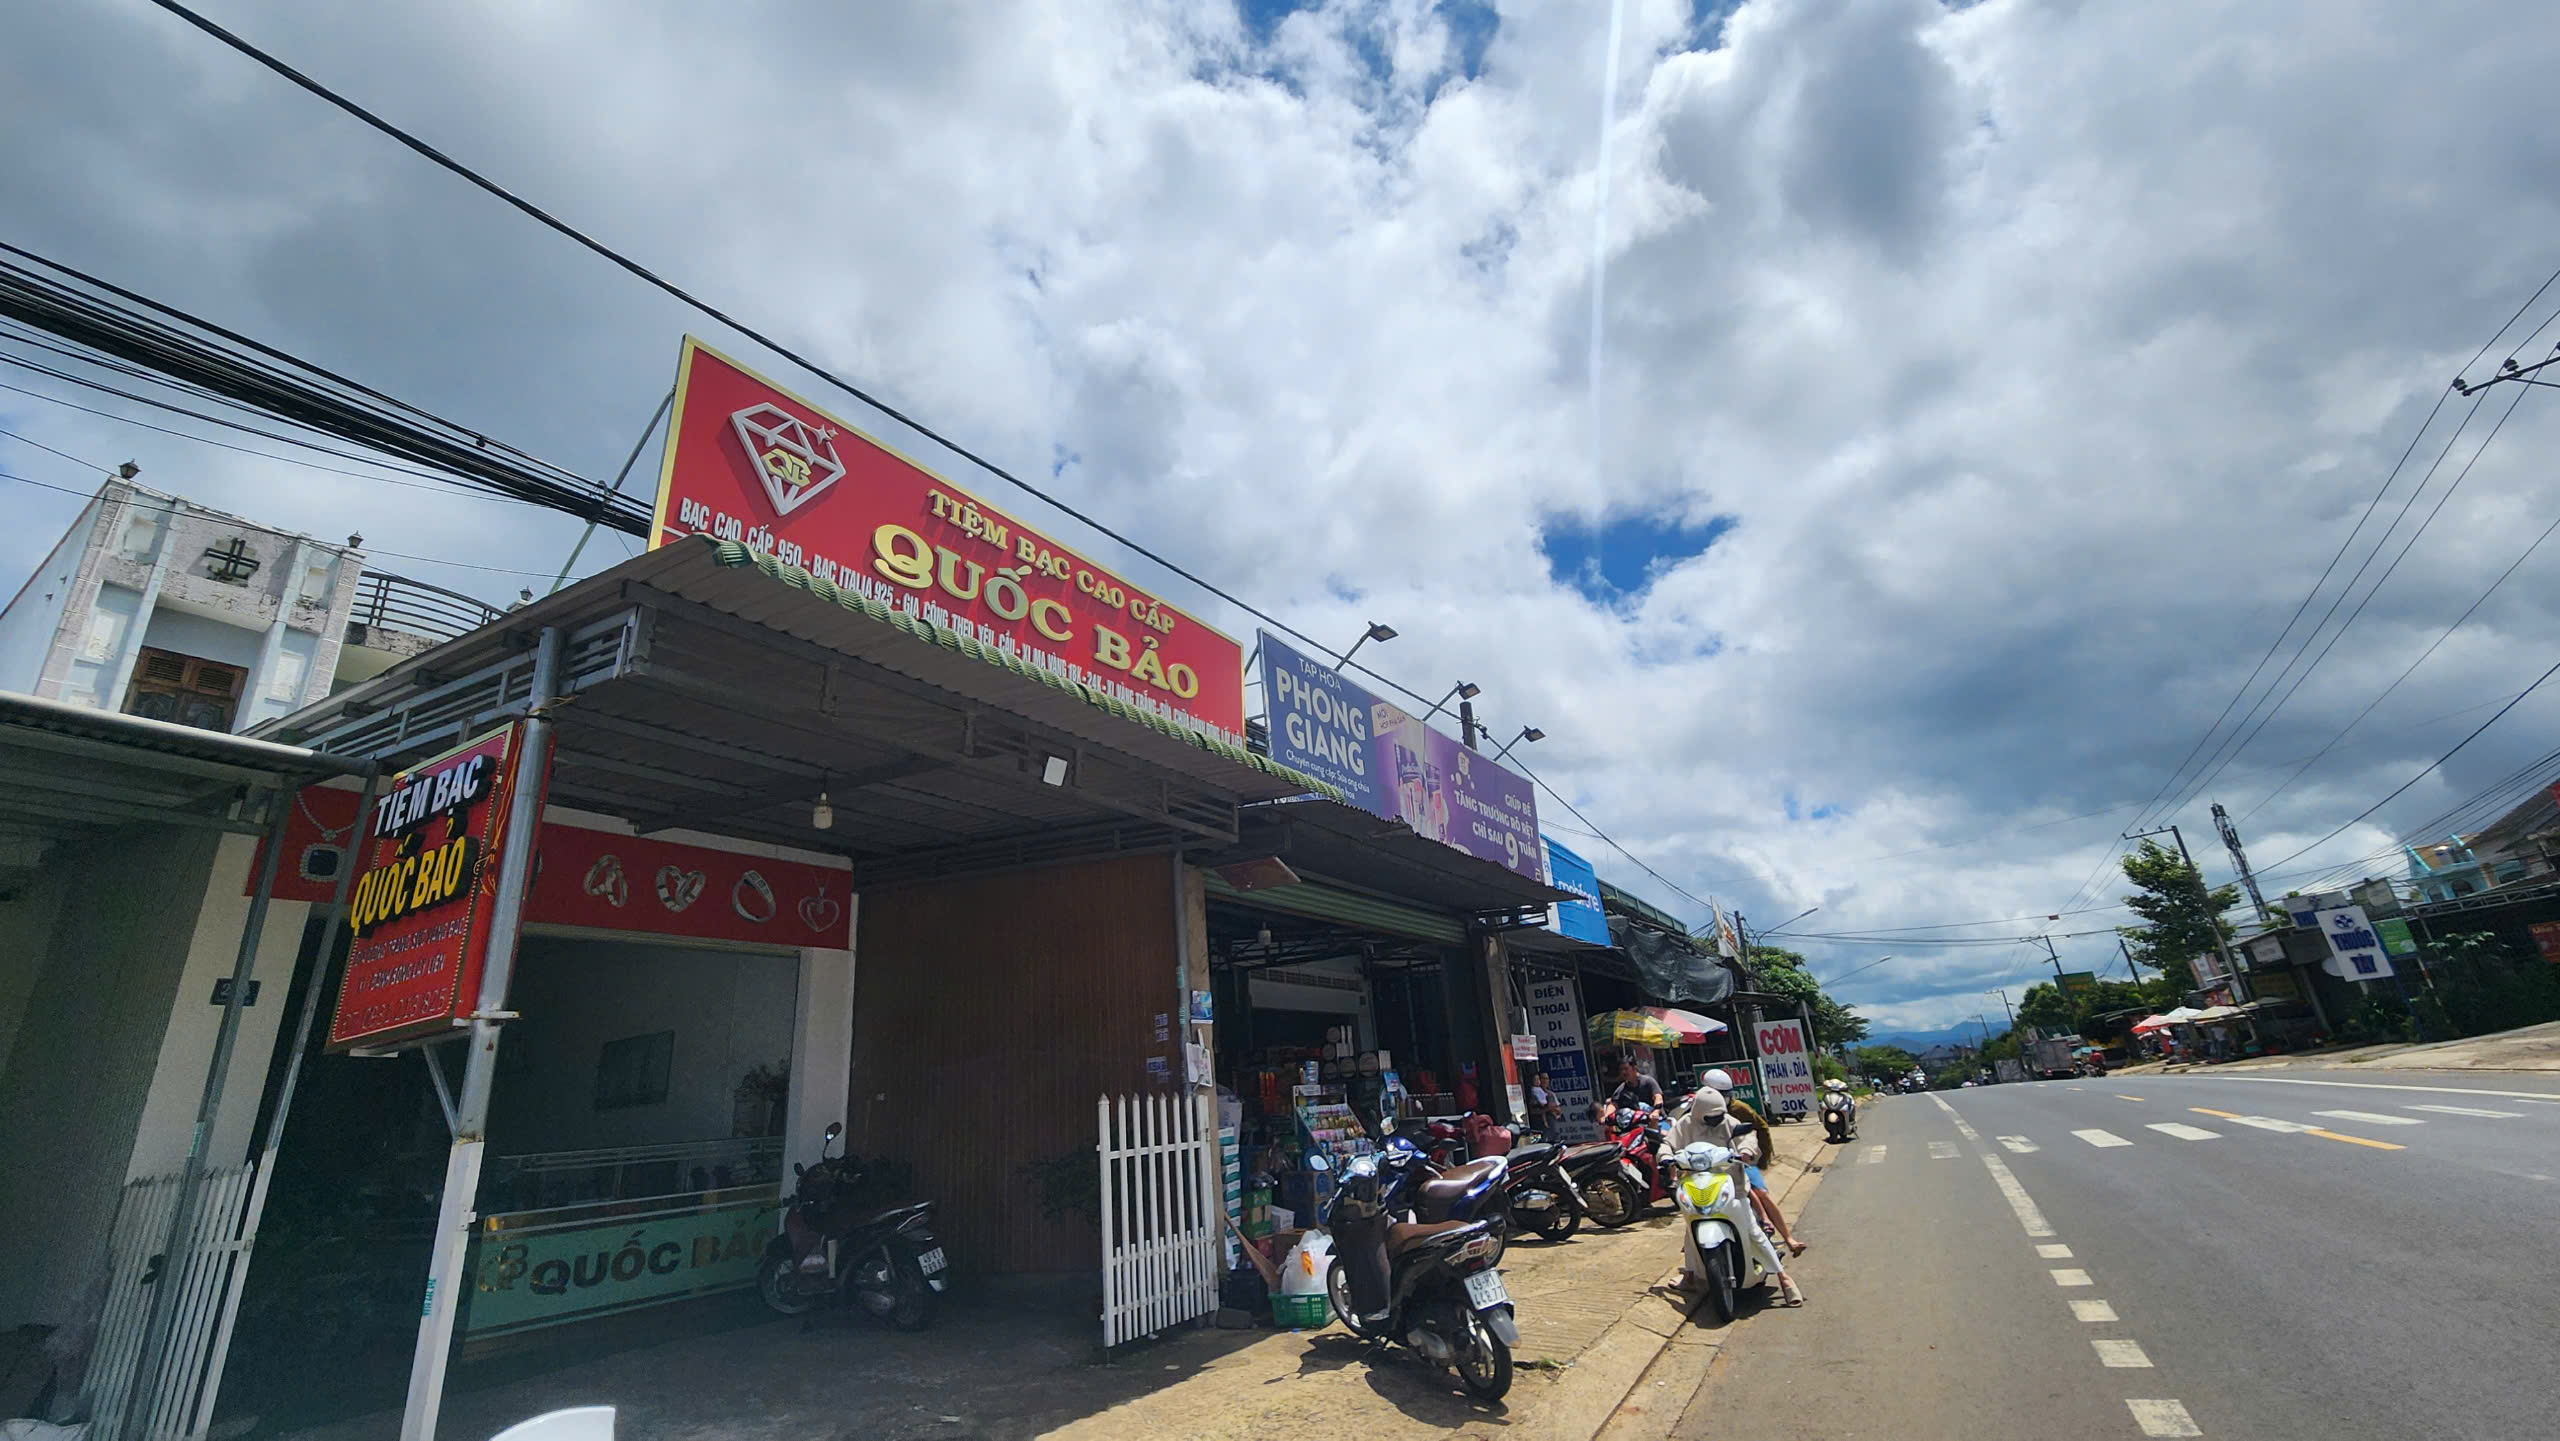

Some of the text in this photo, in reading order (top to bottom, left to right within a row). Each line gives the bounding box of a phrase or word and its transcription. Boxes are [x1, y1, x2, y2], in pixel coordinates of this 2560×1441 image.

[927, 489, 1176, 635] TIỆM BẠC CAO CẤP
[679, 497, 709, 531] BẠC
[714, 512, 742, 542] CAO
[746, 524, 774, 555] CẤP
[777, 539, 803, 568] 950
[838, 565, 873, 599] ITALIA
[874, 581, 894, 606] 925
[902, 593, 920, 618] GIA
[923, 600, 948, 628] CÔNG
[951, 613, 974, 638] THEO
[978, 624, 994, 647] YÊU
[1047, 652, 1067, 677] VÀNG
[872, 524, 1199, 699] QUỐC BẢO
[1276, 666, 1366, 741] PHONG
[1285, 712, 1365, 776] GIANG
[373, 754, 484, 838] TIỆM BẠC
[1454, 789, 1478, 812] TĂNG
[1504, 793, 1532, 818] GIÚP BÉ
[1487, 829, 1504, 845] SAU
[1504, 831, 1519, 869] 9
[351, 817, 466, 937] QUỐC BẢO
[1532, 1002, 1570, 1016] THOẠI
[1534, 984, 1565, 1000] ĐIỆN
[1540, 1035, 1577, 1051] ĐỘNG
[1548, 1020, 1562, 1032] DI
[1760, 1024, 1803, 1056] CƠM
[1771, 1082, 1812, 1097] TỰ CHỌN
[1781, 1098, 1809, 1112] 30K
[529, 1229, 683, 1296] QUỐC
